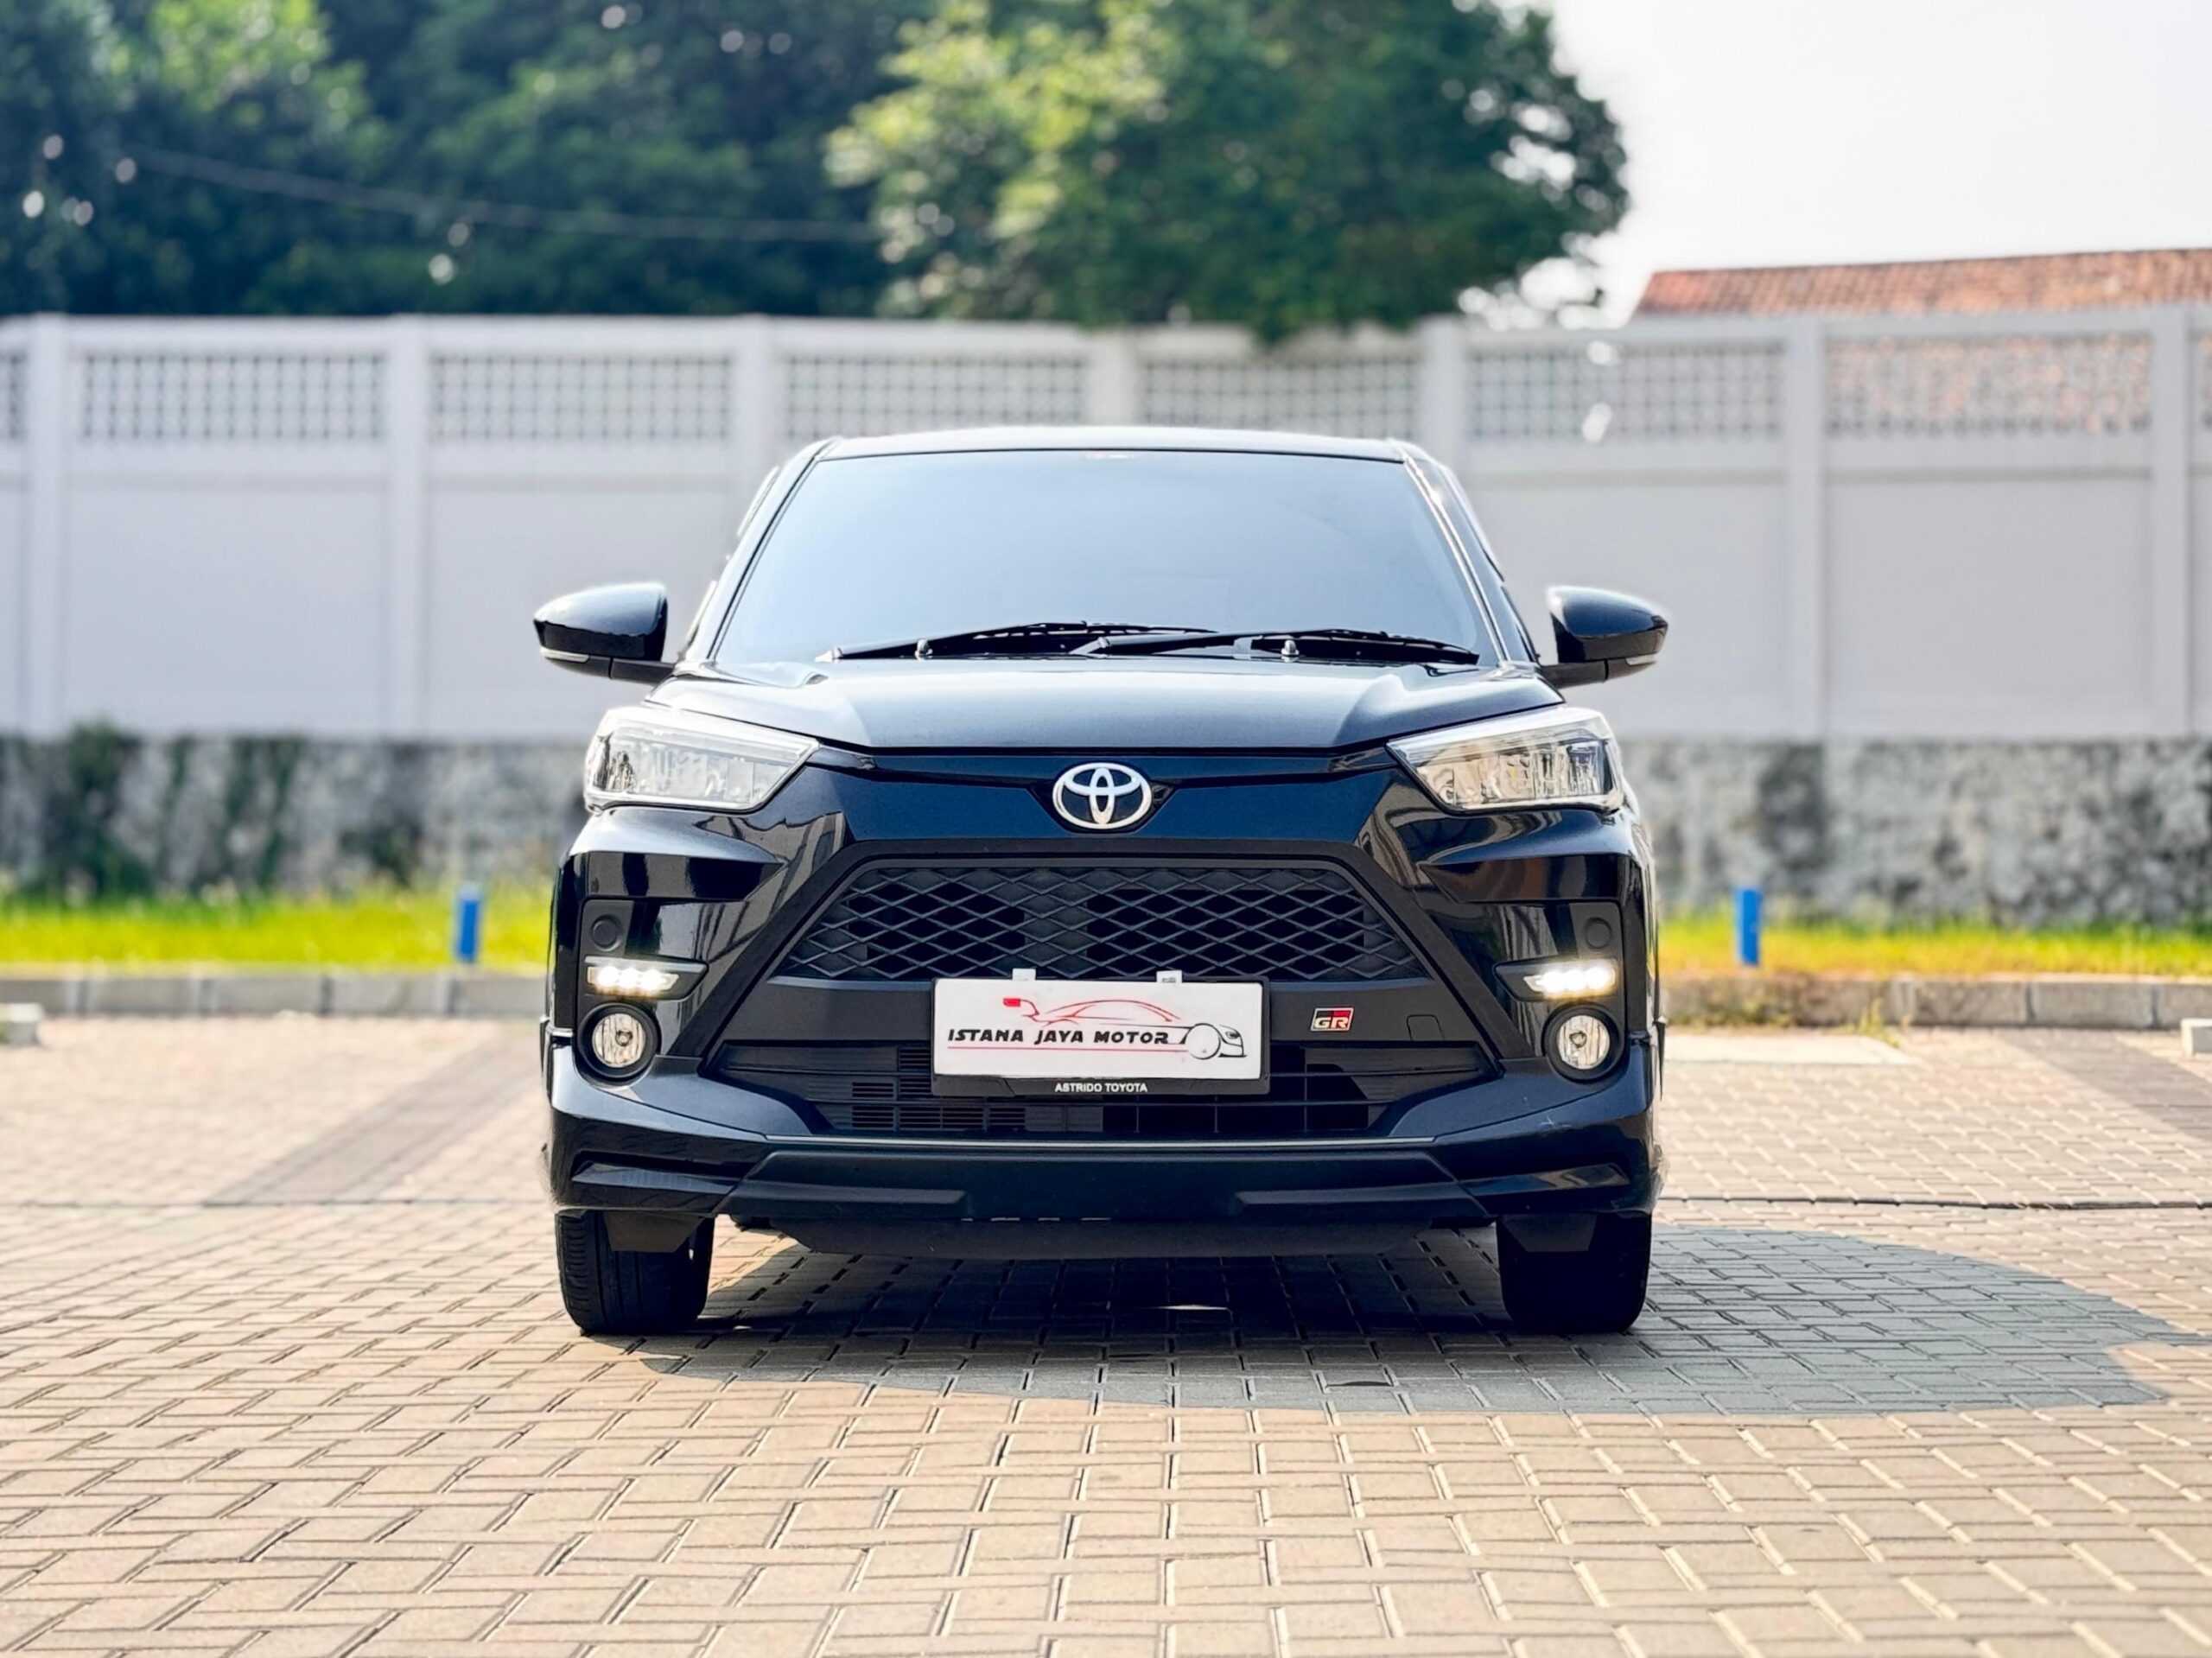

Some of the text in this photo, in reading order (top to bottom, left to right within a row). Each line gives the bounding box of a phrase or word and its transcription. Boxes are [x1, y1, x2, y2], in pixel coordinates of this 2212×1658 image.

[1313, 1017, 1349, 1028] GR
[948, 1028, 1169, 1045] ISTANA JAYA MOTOR
[1054, 1083, 1148, 1092] ASTRIDO TOYOTA
